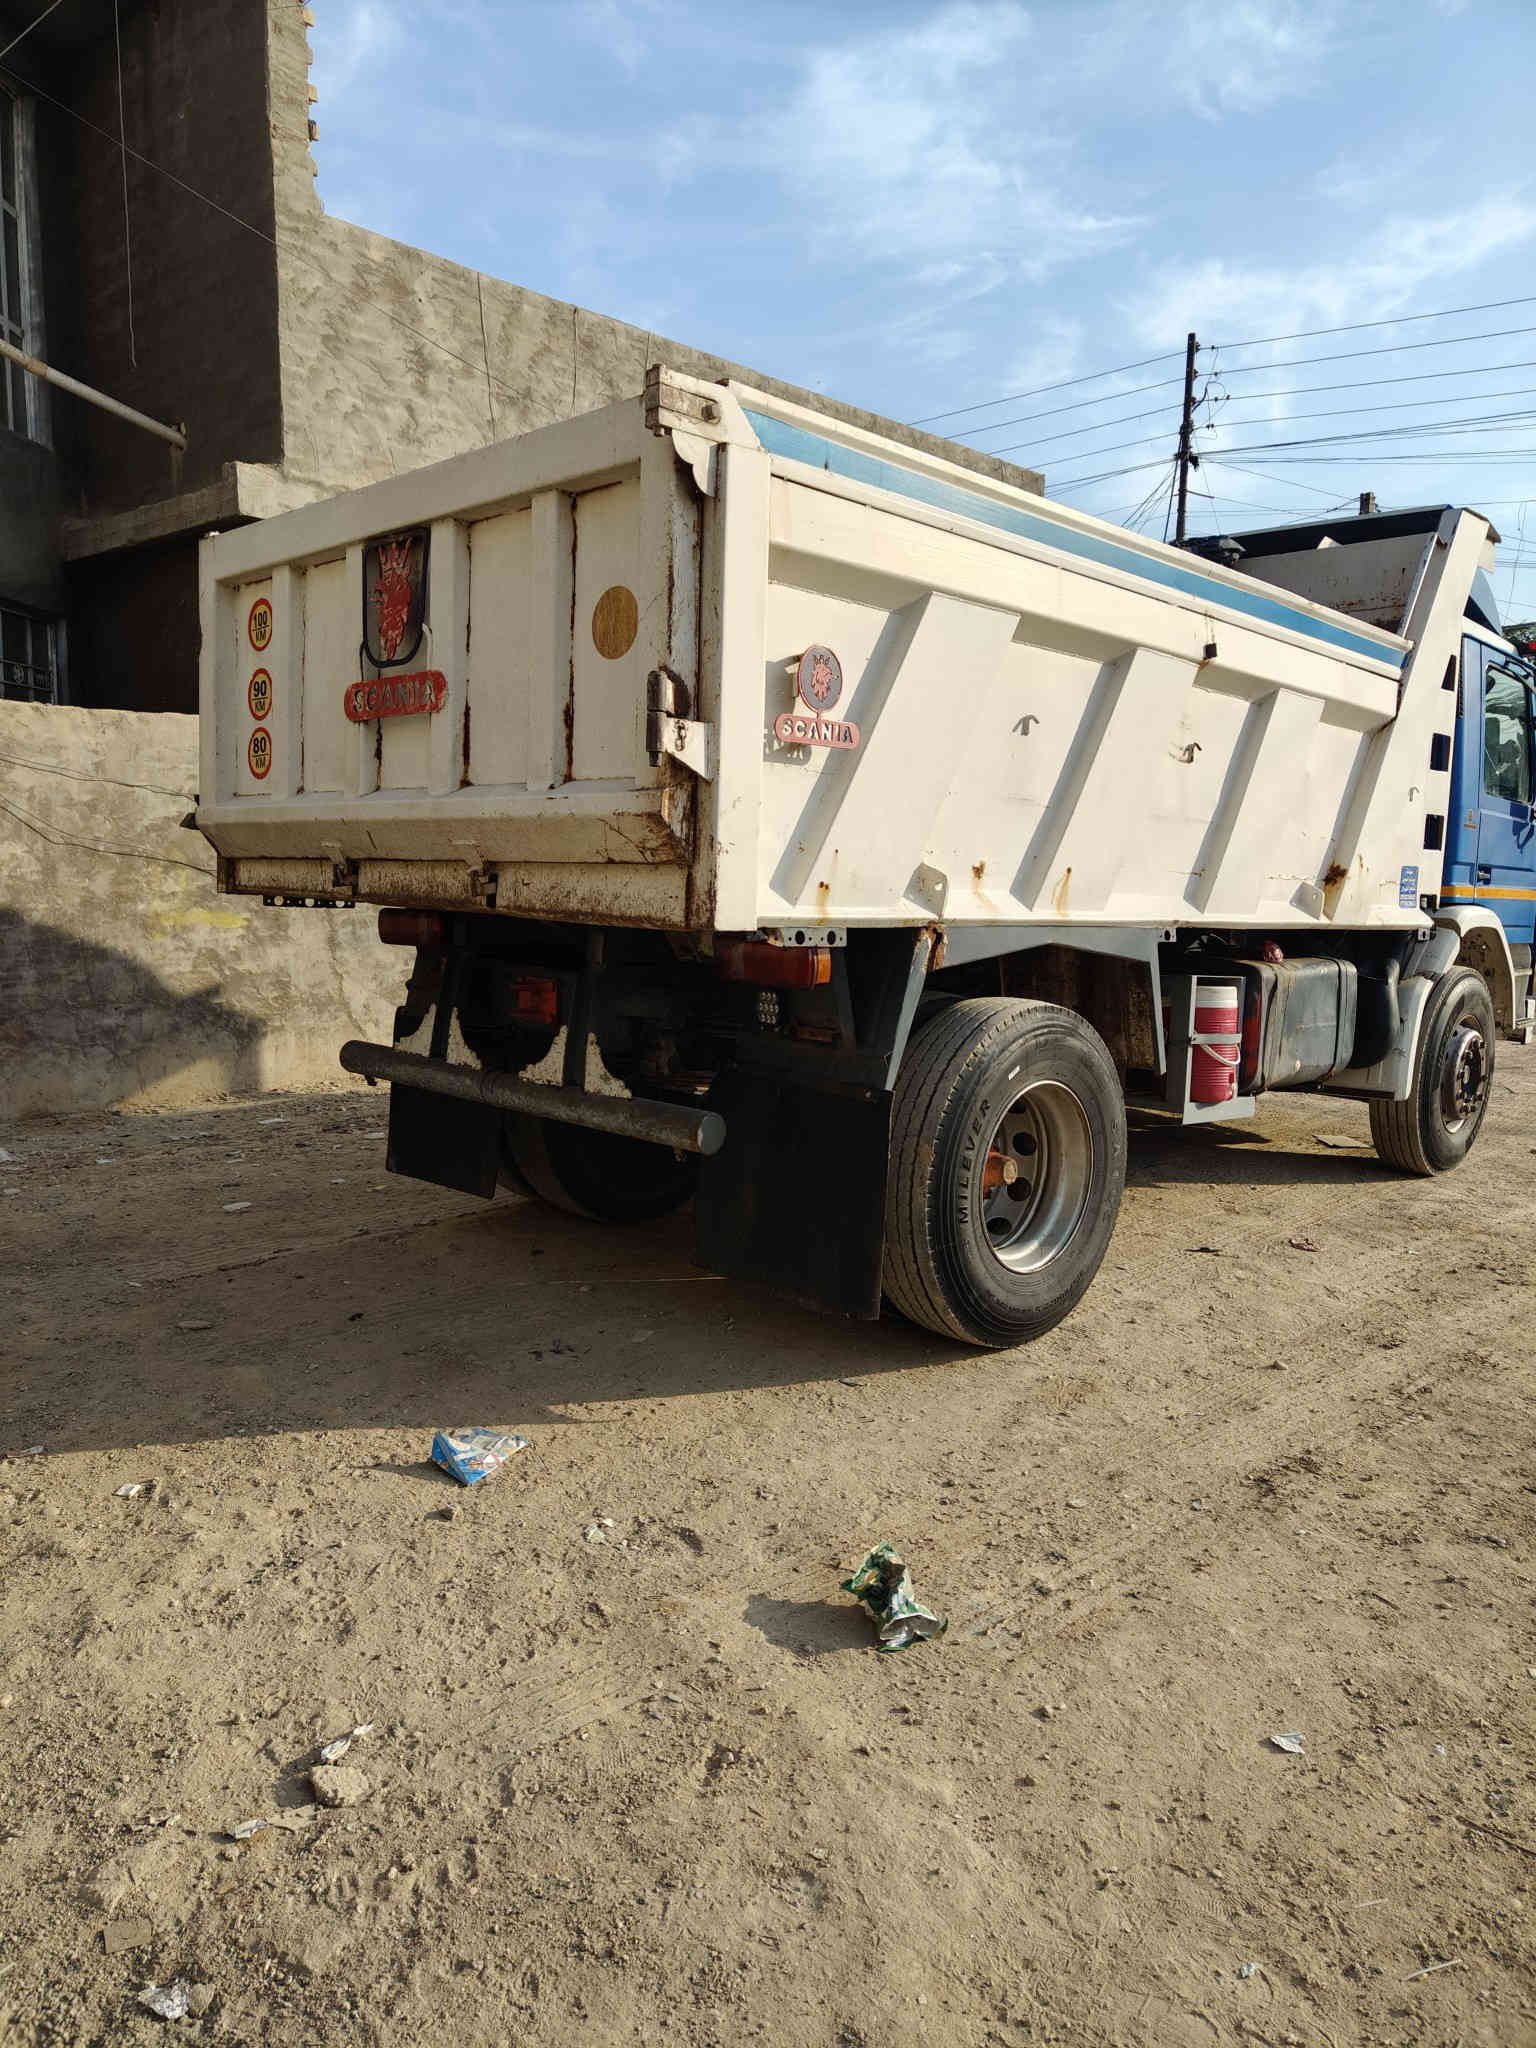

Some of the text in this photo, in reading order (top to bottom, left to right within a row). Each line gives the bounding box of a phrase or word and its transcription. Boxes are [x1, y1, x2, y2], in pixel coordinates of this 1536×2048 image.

[253, 610, 268, 627] 100
[255, 629, 267, 642] KM
[253, 680, 267, 697] 90
[353, 680, 435, 712] SCANIA
[254, 700, 266, 712] KM
[782, 718, 854, 744] SCANIA
[253, 736, 267, 754] 80
[255, 757, 266, 769] KM
[958, 1099, 991, 1225] MILEVER
